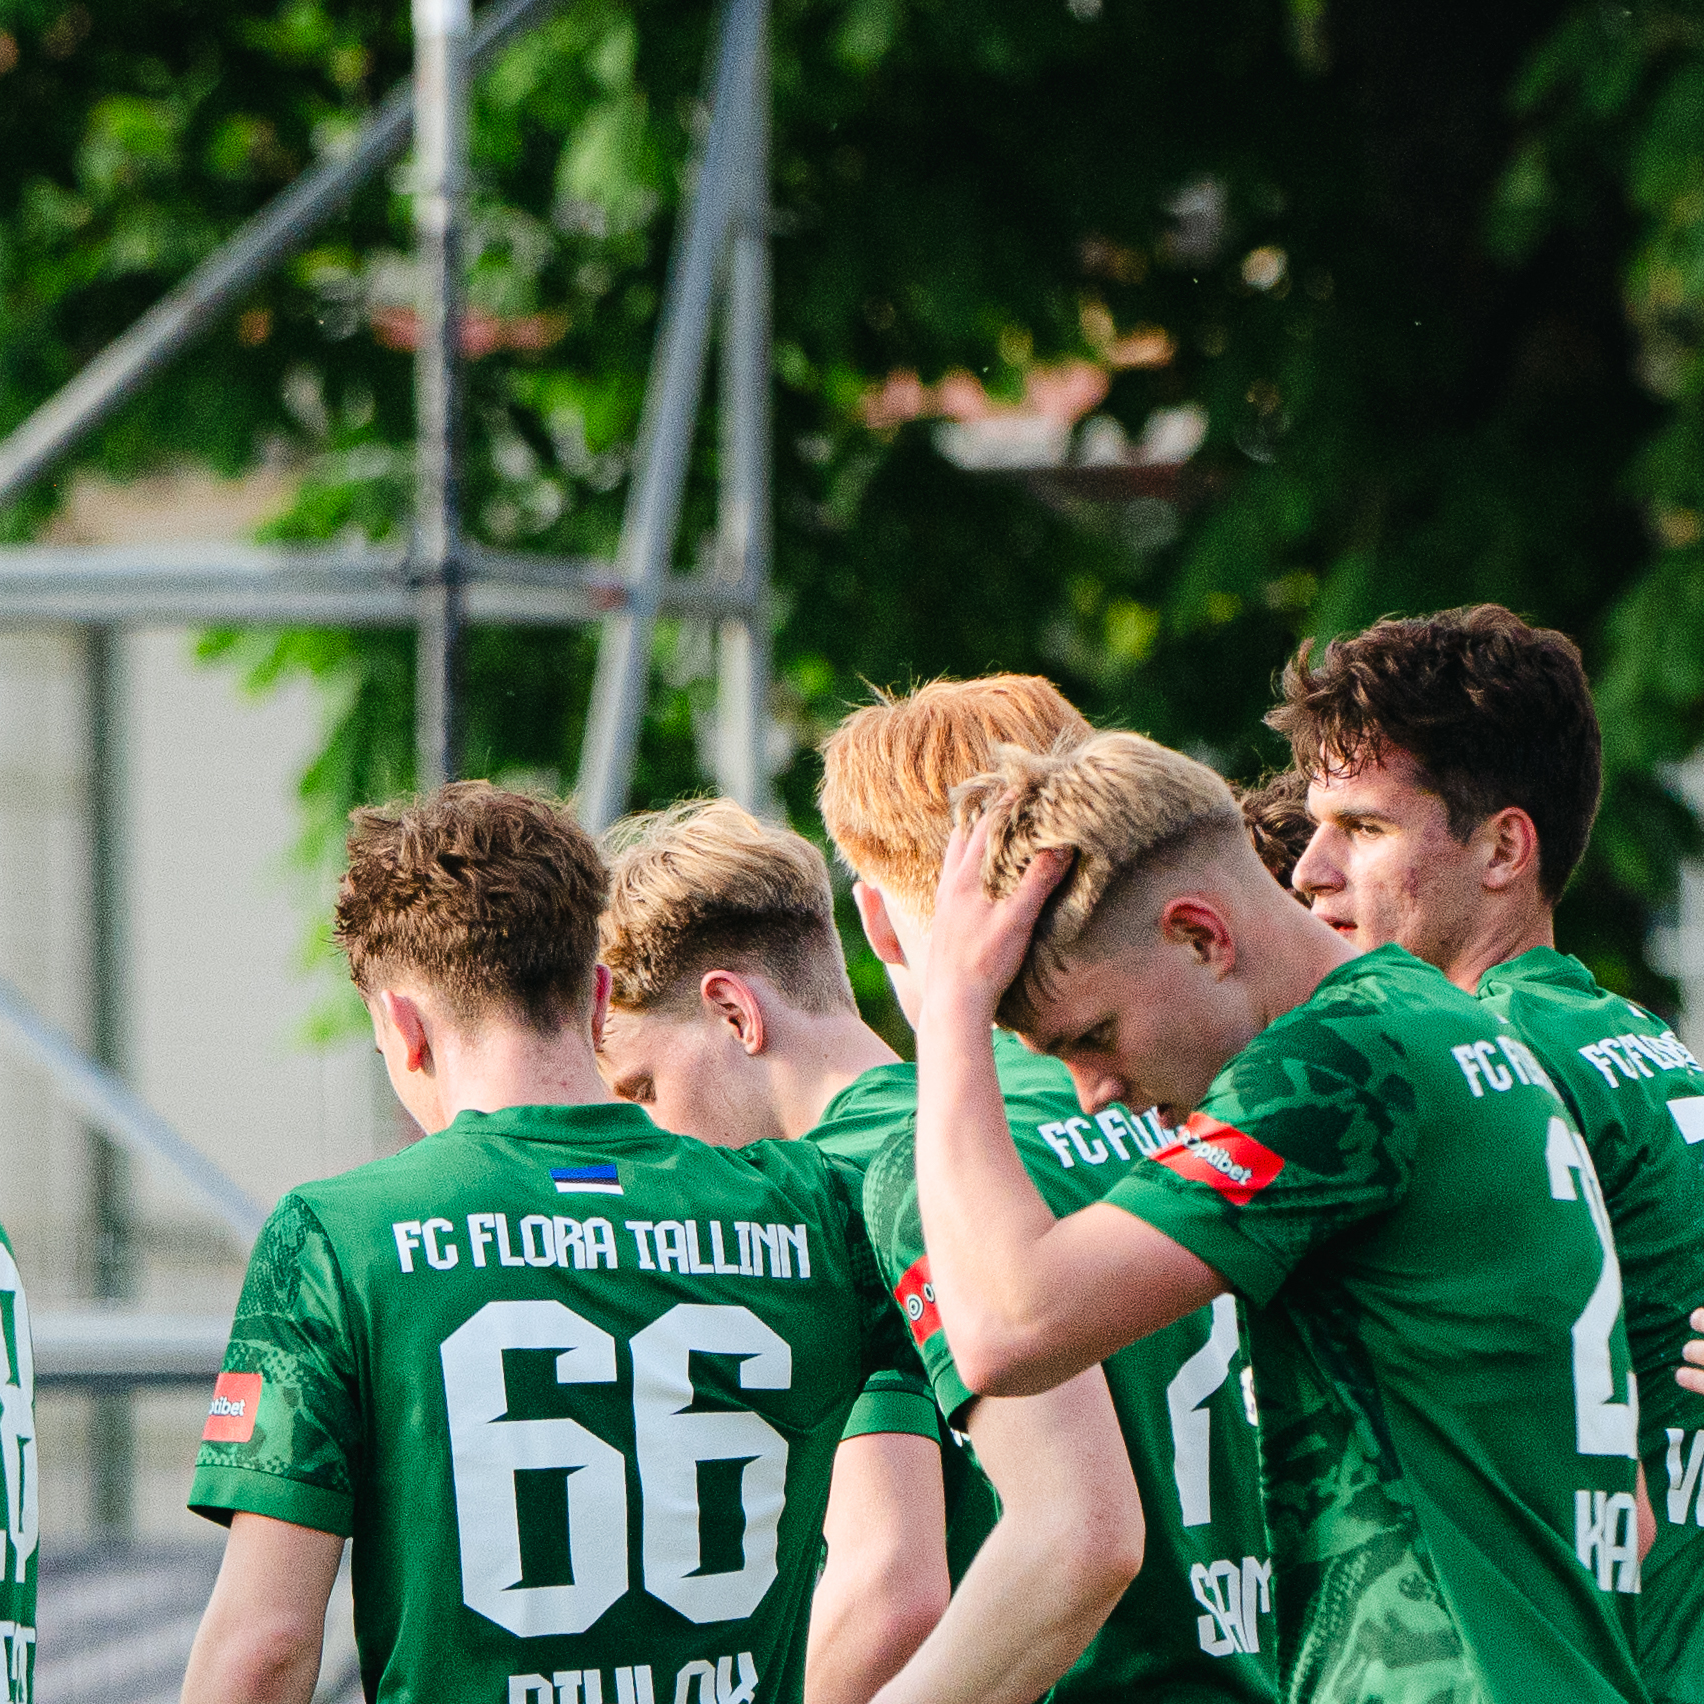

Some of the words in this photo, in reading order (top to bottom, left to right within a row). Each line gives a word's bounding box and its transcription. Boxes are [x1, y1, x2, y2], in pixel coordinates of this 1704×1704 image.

[1451, 1040, 1513, 1097] FC
[1038, 1116, 1108, 1168] FC
[393, 1210, 458, 1273] FC
[467, 1203, 618, 1269] FLORA
[625, 1219, 810, 1278] TALLINN
[440, 1300, 792, 1638] 66
